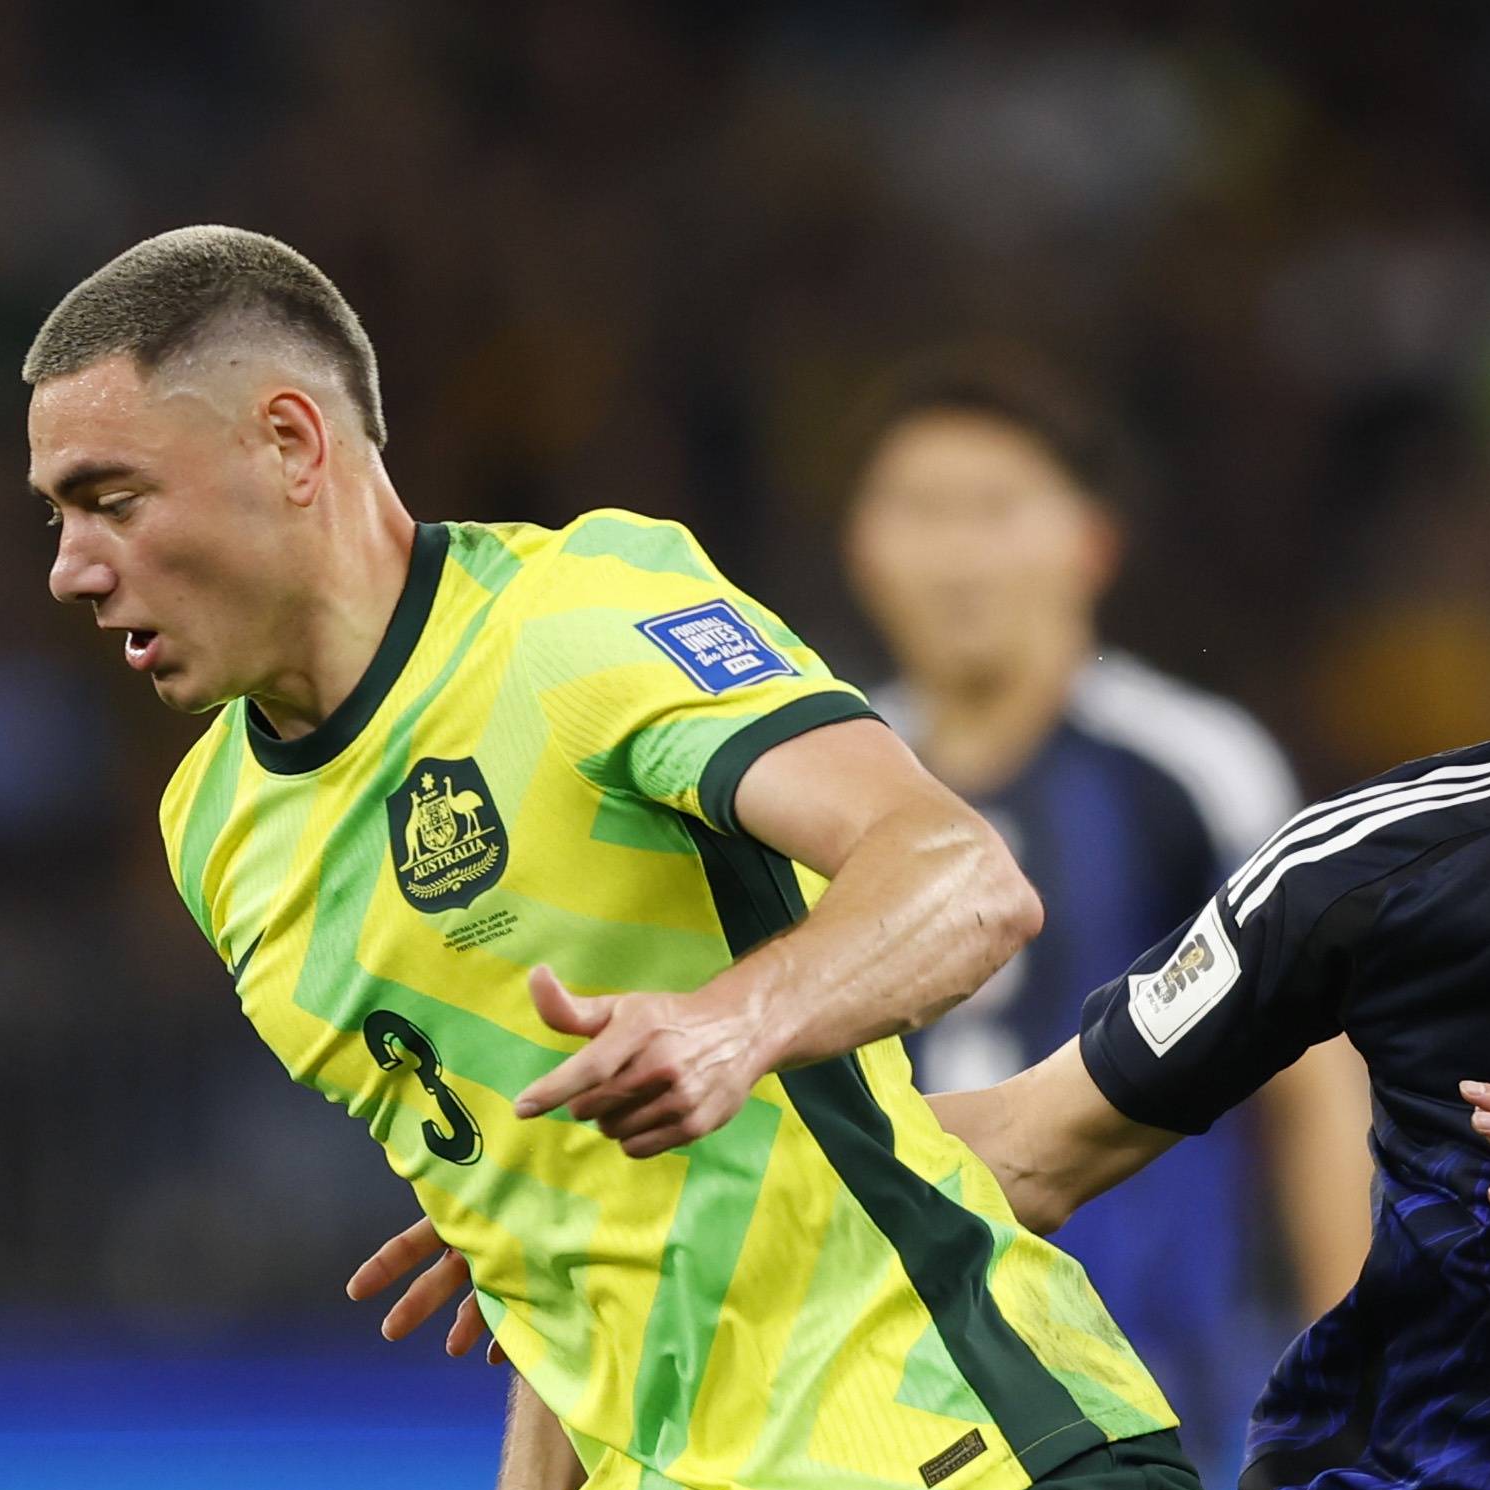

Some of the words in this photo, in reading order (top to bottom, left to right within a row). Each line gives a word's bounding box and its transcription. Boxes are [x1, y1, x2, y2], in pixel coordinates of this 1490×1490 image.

[668, 616, 728, 640] FOOTBALL
[679, 624, 743, 653] UNITES
[695, 649, 722, 667] the
[716, 639, 760, 658] World
[731, 658, 757, 670] FIFA
[412, 837, 488, 881] AUSTRALIA
[362, 1008, 484, 1167] 3
